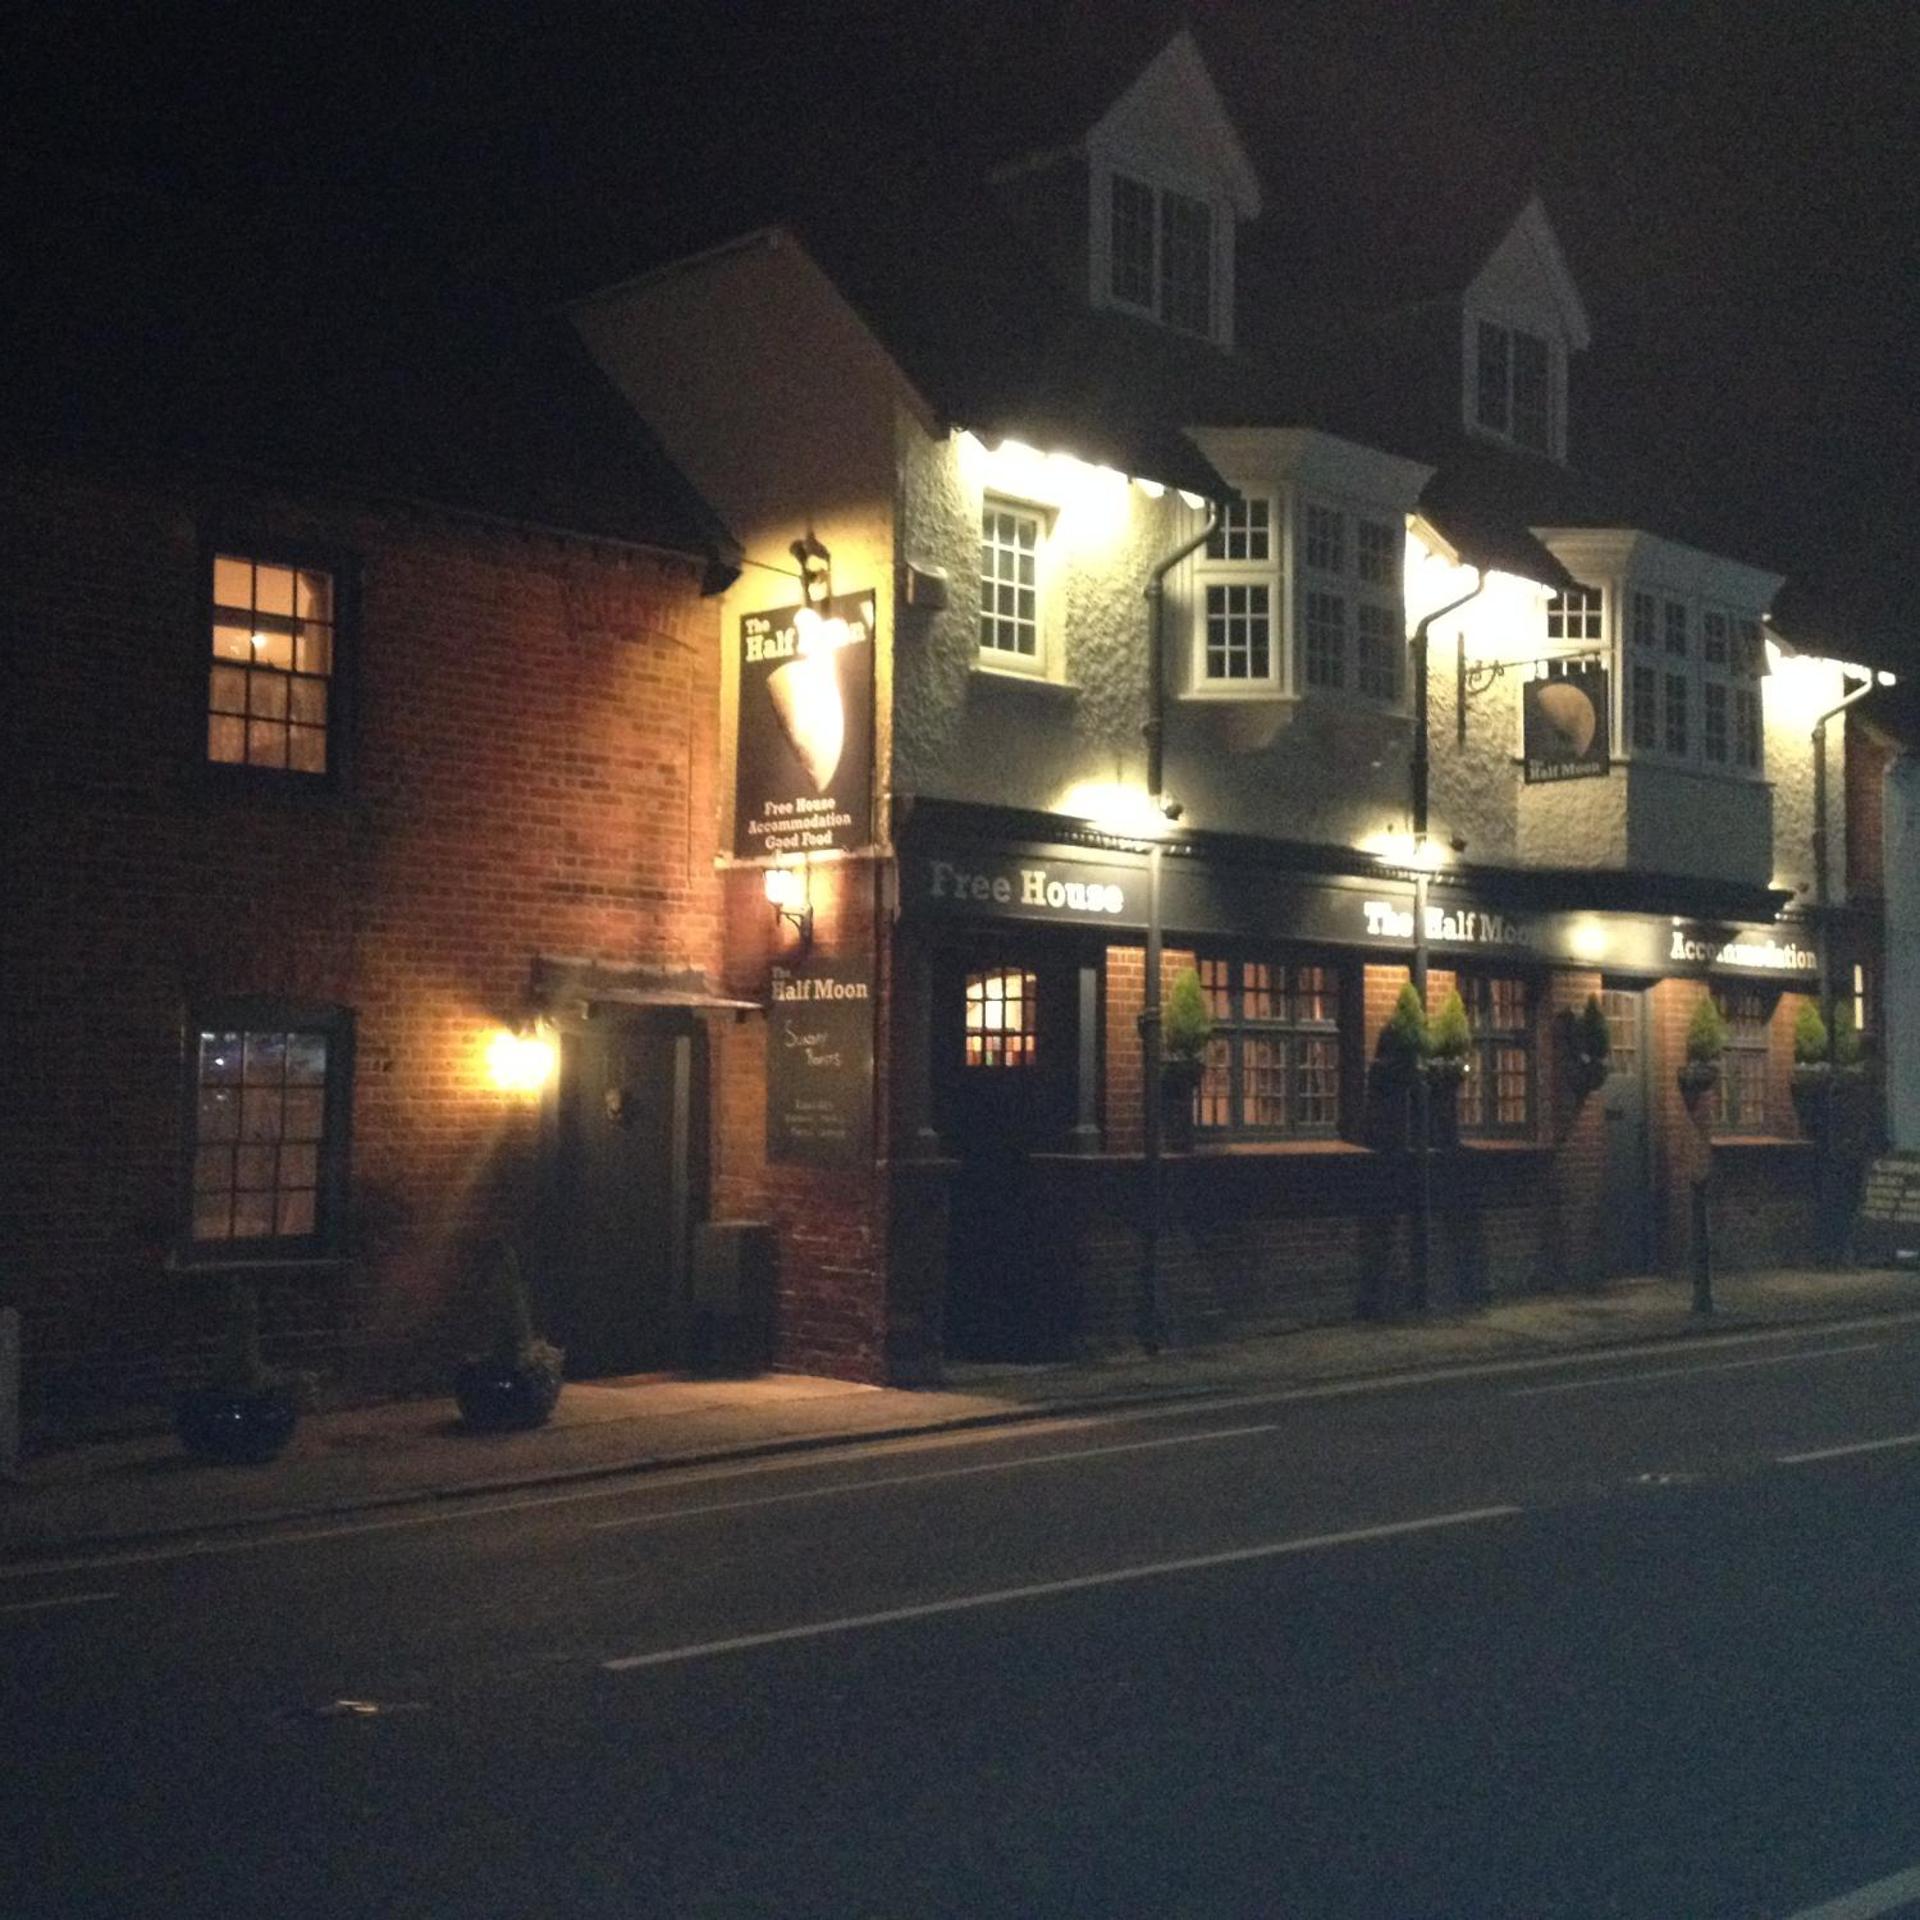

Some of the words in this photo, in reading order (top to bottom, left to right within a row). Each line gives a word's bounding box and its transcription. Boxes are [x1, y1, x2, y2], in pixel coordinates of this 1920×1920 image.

[745, 618, 771, 635] The
[745, 627, 796, 662] Half
[1529, 764, 1558, 780] Half
[1561, 761, 1601, 777] Moon
[764, 801, 793, 816] Free
[796, 797, 836, 813] House
[748, 811, 852, 835] Accommodation
[764, 832, 799, 850] Good
[801, 829, 833, 847] Food
[929, 860, 1011, 903] Free
[1021, 870, 1124, 913] House
[1363, 901, 1415, 938] The
[1424, 906, 1477, 941] Half
[1480, 911, 1540, 947] Moo
[772, 966, 791, 979] The
[772, 979, 812, 1001] Half
[814, 978, 868, 1000] Moon
